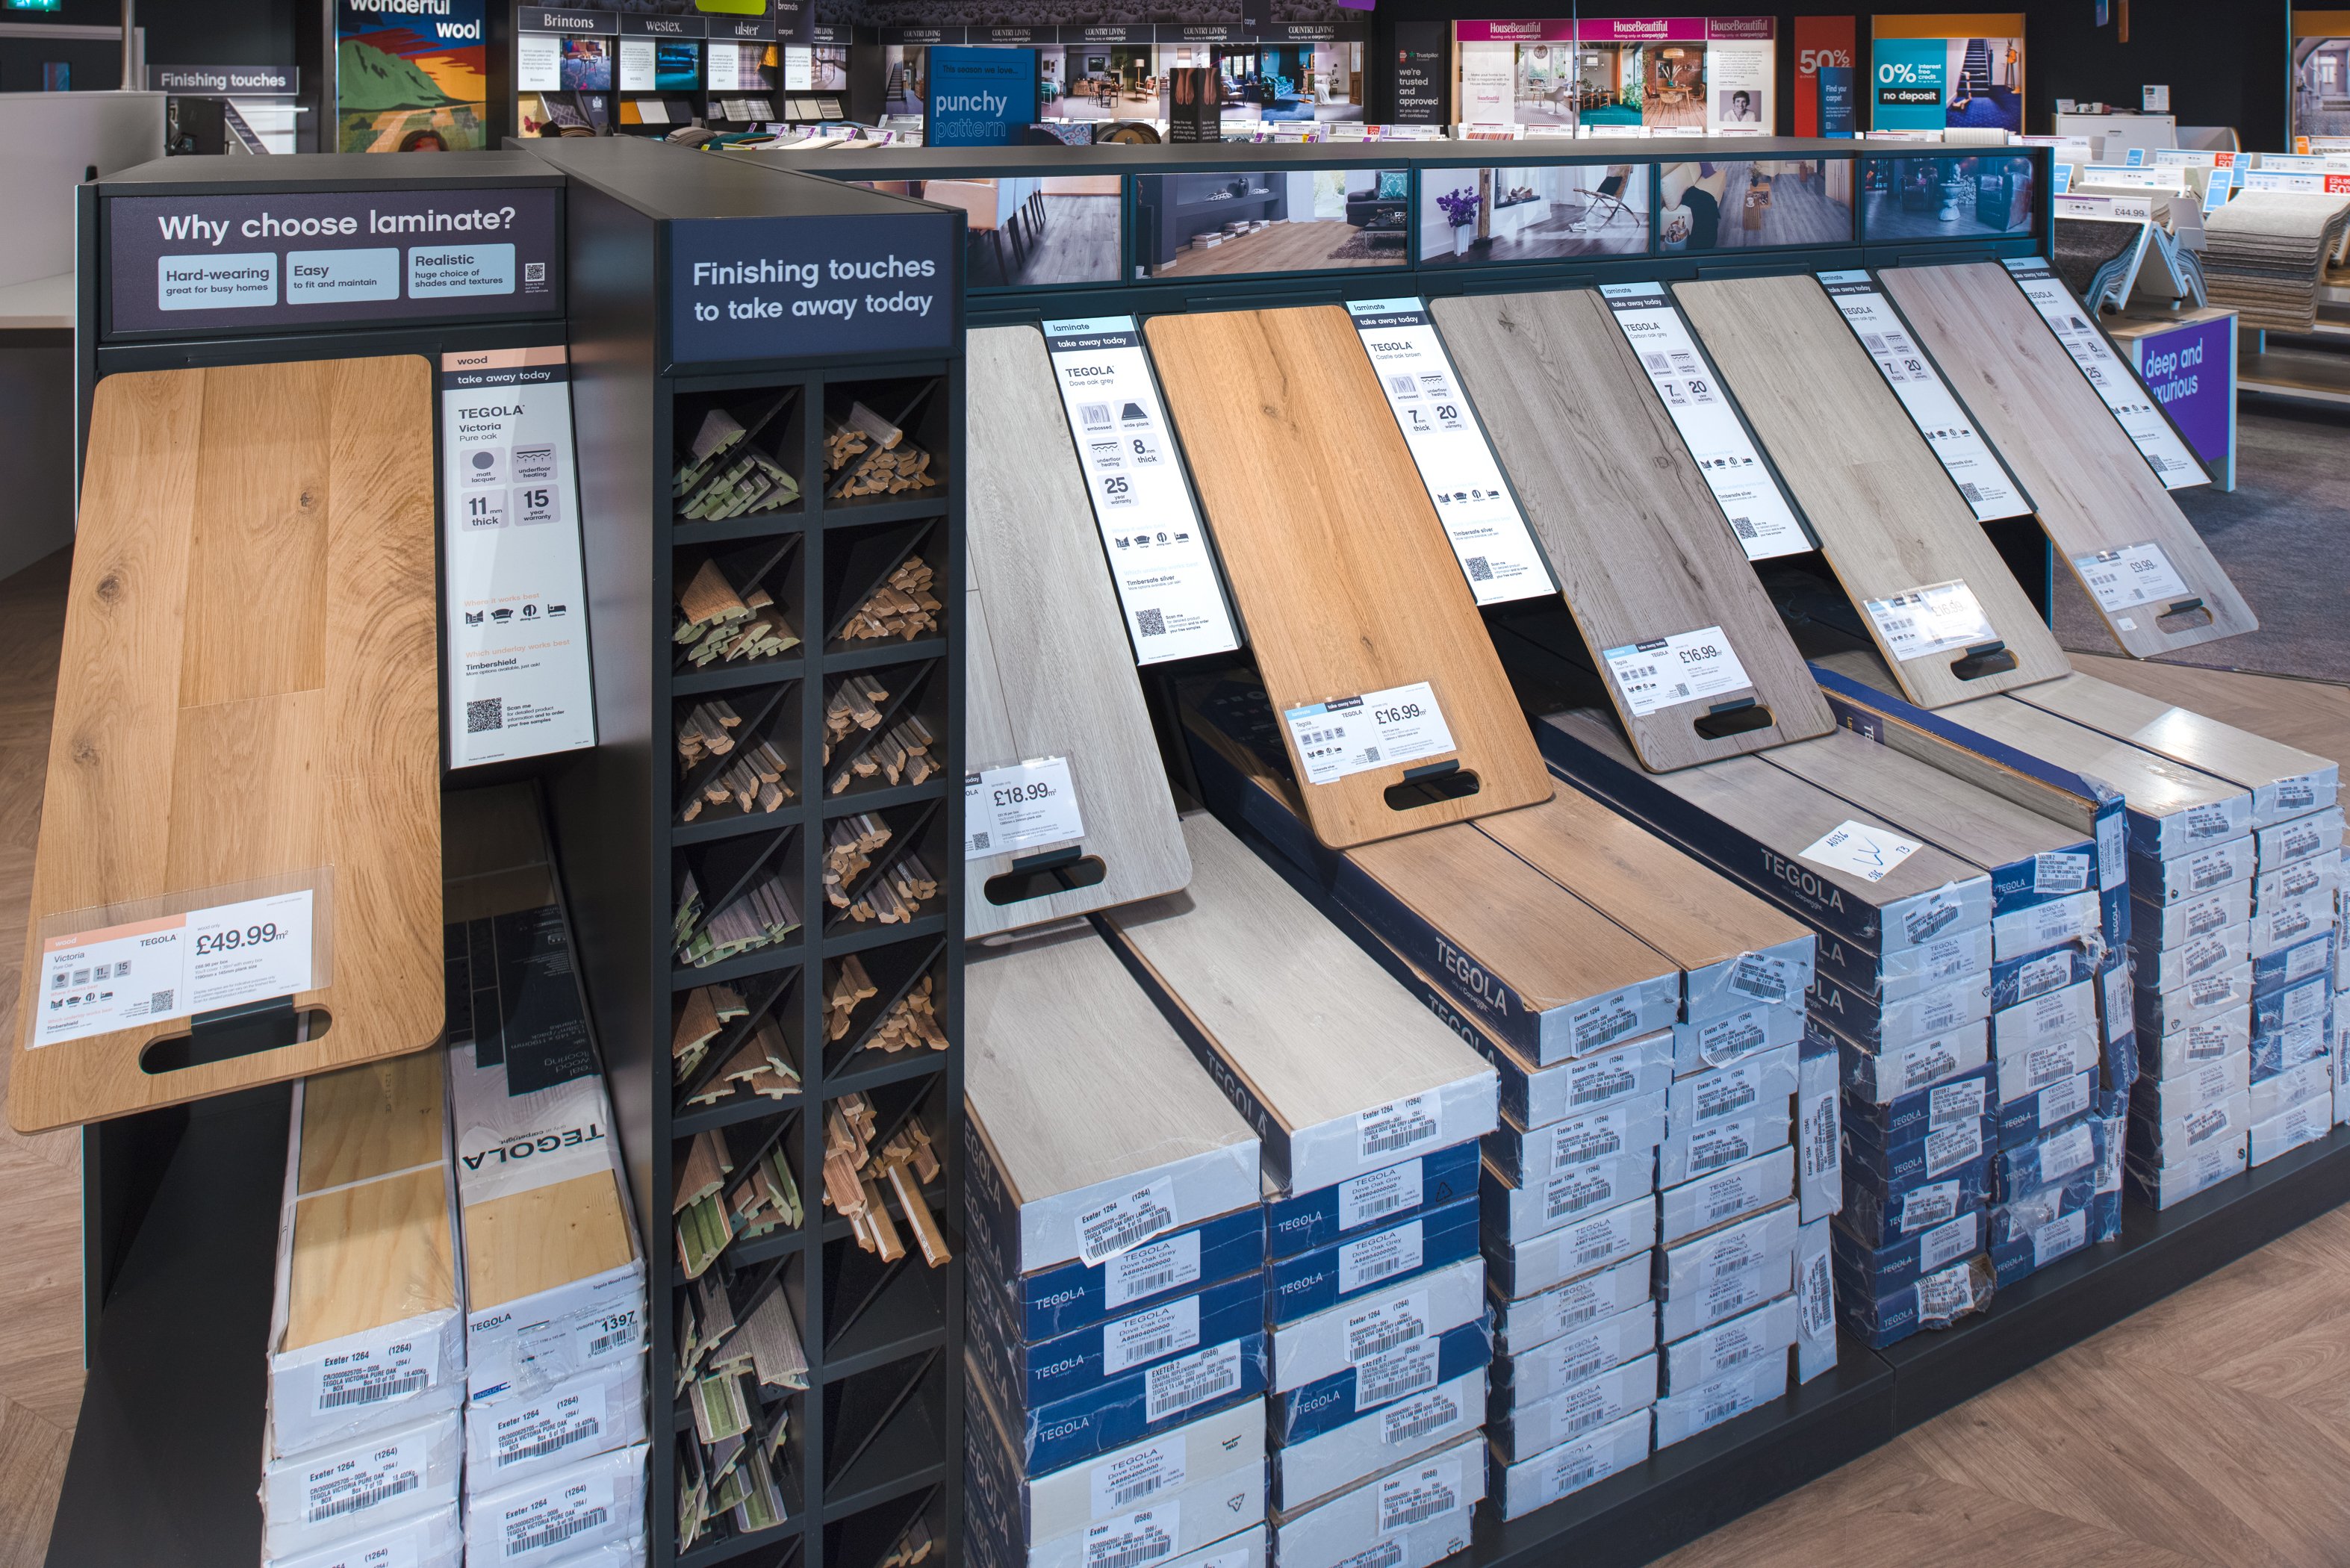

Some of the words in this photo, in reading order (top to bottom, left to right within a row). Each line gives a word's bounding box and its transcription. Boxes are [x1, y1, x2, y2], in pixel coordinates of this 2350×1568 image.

[544, 13, 594, 28] Brintons
[436, 19, 479, 40] wool
[736, 22, 758, 35] ulster
[943, 65, 955, 73] This
[1879, 64, 1916, 83] 0%
[161, 73, 227, 90] Finishing
[231, 73, 285, 87] touches
[936, 90, 1007, 117] punchy
[1399, 97, 1438, 107] approved
[1899, 92, 1936, 102] deposit
[936, 119, 1005, 143] pattern
[158, 214, 230, 246] Why
[242, 212, 358, 237] choose
[370, 207, 515, 234] laminate?
[416, 255, 474, 267] Realistic
[167, 268, 269, 281] Hard-wearing
[294, 265, 329, 278] Easy
[415, 271, 437, 280] huge
[440, 270, 468, 278] choice
[694, 258, 819, 289] Finishing
[829, 255, 935, 283] touches
[338, 278, 377, 287] maintain
[415, 279, 447, 287] shades
[450, 278, 466, 286] and
[167, 286, 191, 296] great
[211, 285, 232, 293] busy
[237, 284, 268, 292] homes
[694, 301, 718, 321] to
[728, 298, 782, 320] take
[792, 298, 857, 320] away
[865, 293, 932, 317] today
[1054, 323, 1089, 332] laminate
[1624, 323, 1659, 332] TEGOLA
[1058, 339, 1076, 348] take
[1079, 338, 1101, 346] away
[1103, 337, 1126, 345] today
[1371, 342, 1411, 352] TEGOLA
[458, 356, 488, 365] wood
[2146, 351, 2176, 379] deep
[2181, 337, 2202, 368] and
[458, 376, 482, 385] take
[486, 374, 516, 383] away
[520, 371, 550, 380] today
[1066, 366, 1114, 377] TEGOLA
[1664, 385, 1674, 396] 7
[1689, 381, 1707, 393] 20
[2147, 375, 2198, 404] uxurious
[459, 405, 523, 420] TEGOLA
[1408, 410, 1417, 423] 7
[1437, 405, 1457, 419] 20
[459, 423, 501, 432] Victoria
[1133, 440, 1146, 454] 8
[1104, 477, 1128, 494] 25
[524, 490, 549, 508] 15
[469, 497, 486, 516] 11
[472, 517, 498, 526] thick
[466, 659, 516, 671] Timbershield
[1760, 848, 1844, 914] TEGOLA
[140, 935, 177, 947] TEGOLA
[55, 951, 84, 962] Victoria
[1435, 936, 1507, 1016] TEGOLA
[463, 1124, 605, 1171] TEGOLA
[1279, 1211, 1322, 1233] TEGOLA
[1121, 1261, 1139, 1270] Dove
[1159, 1249, 1175, 1258] Grey
[1124, 1243, 1170, 1262] TEGOLA
[594, 1282, 607, 1290] Tegola
[608, 1278, 621, 1286] Wood
[621, 1272, 638, 1282] Flooring
[1036, 1287, 1084, 1311] TEGOLA
[470, 1313, 511, 1332] TEGOLA
[576, 1321, 594, 1331] Victoria
[595, 1316, 606, 1325] Pure
[602, 1311, 635, 1332] 1397
[388, 1343, 411, 1355] (1264)
[1201, 1348, 1218, 1360] (0586)
[325, 1356, 348, 1366] Exeter
[352, 1351, 369, 1361] 1264
[1152, 1364, 1174, 1378] EXETER
